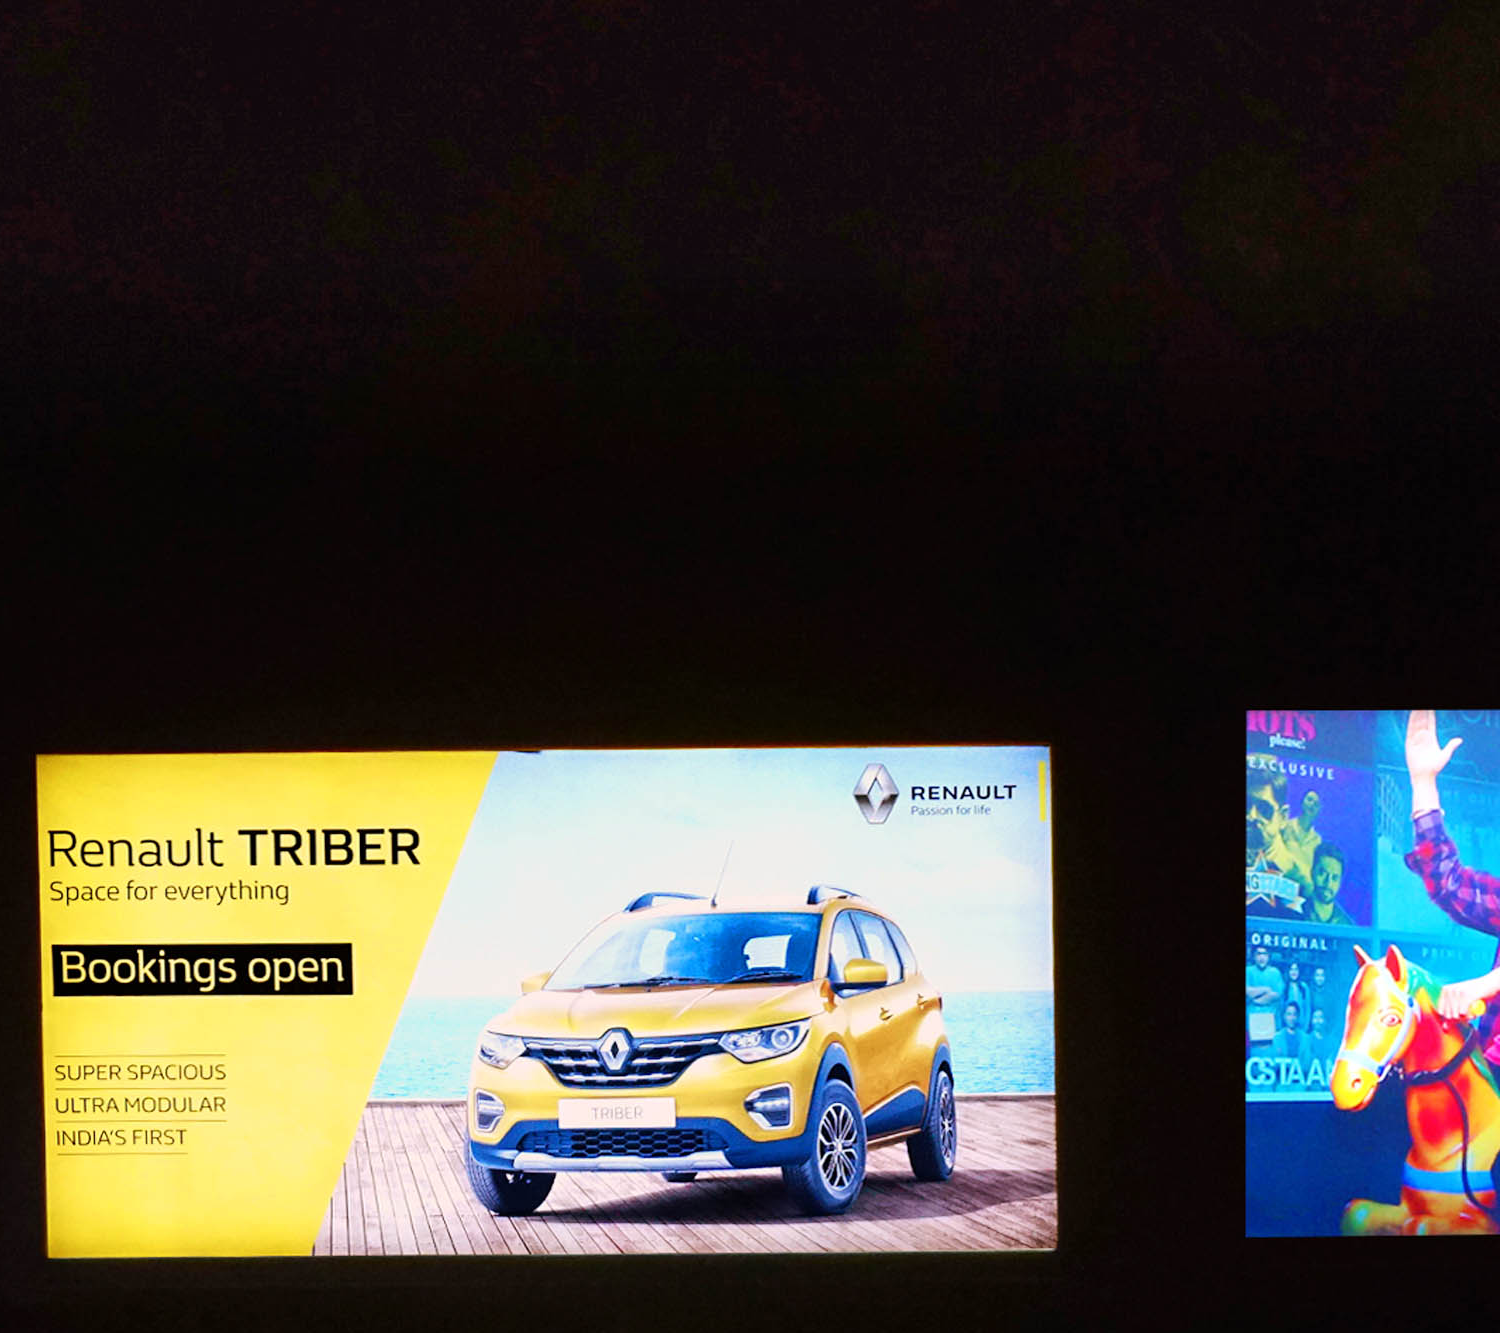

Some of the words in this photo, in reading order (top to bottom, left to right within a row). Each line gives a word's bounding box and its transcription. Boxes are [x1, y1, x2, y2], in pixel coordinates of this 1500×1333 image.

[1246, 755, 1335, 780] EXCLUSIVE
[910, 784, 1018, 801] RENAULT
[910, 805, 954, 816] Passion
[955, 804, 972, 816] for
[973, 804, 992, 816] life
[47, 827, 225, 868] Renault
[238, 827, 421, 867] TRIBER
[49, 880, 120, 906] Space
[125, 879, 159, 902] for
[164, 879, 290, 906] everything
[1251, 932, 1328, 951] ORIGINAL
[60, 949, 238, 992] Bookings
[247, 953, 345, 991] open
[54, 1064, 122, 1081] SUPER
[126, 1063, 227, 1081] SPACIOUS
[54, 1096, 120, 1114] ULTRA
[124, 1096, 227, 1113] MODULAR
[592, 1106, 644, 1120] TRIBER
[56, 1129, 127, 1147] INDIA'S
[131, 1128, 188, 1146] FIRST
